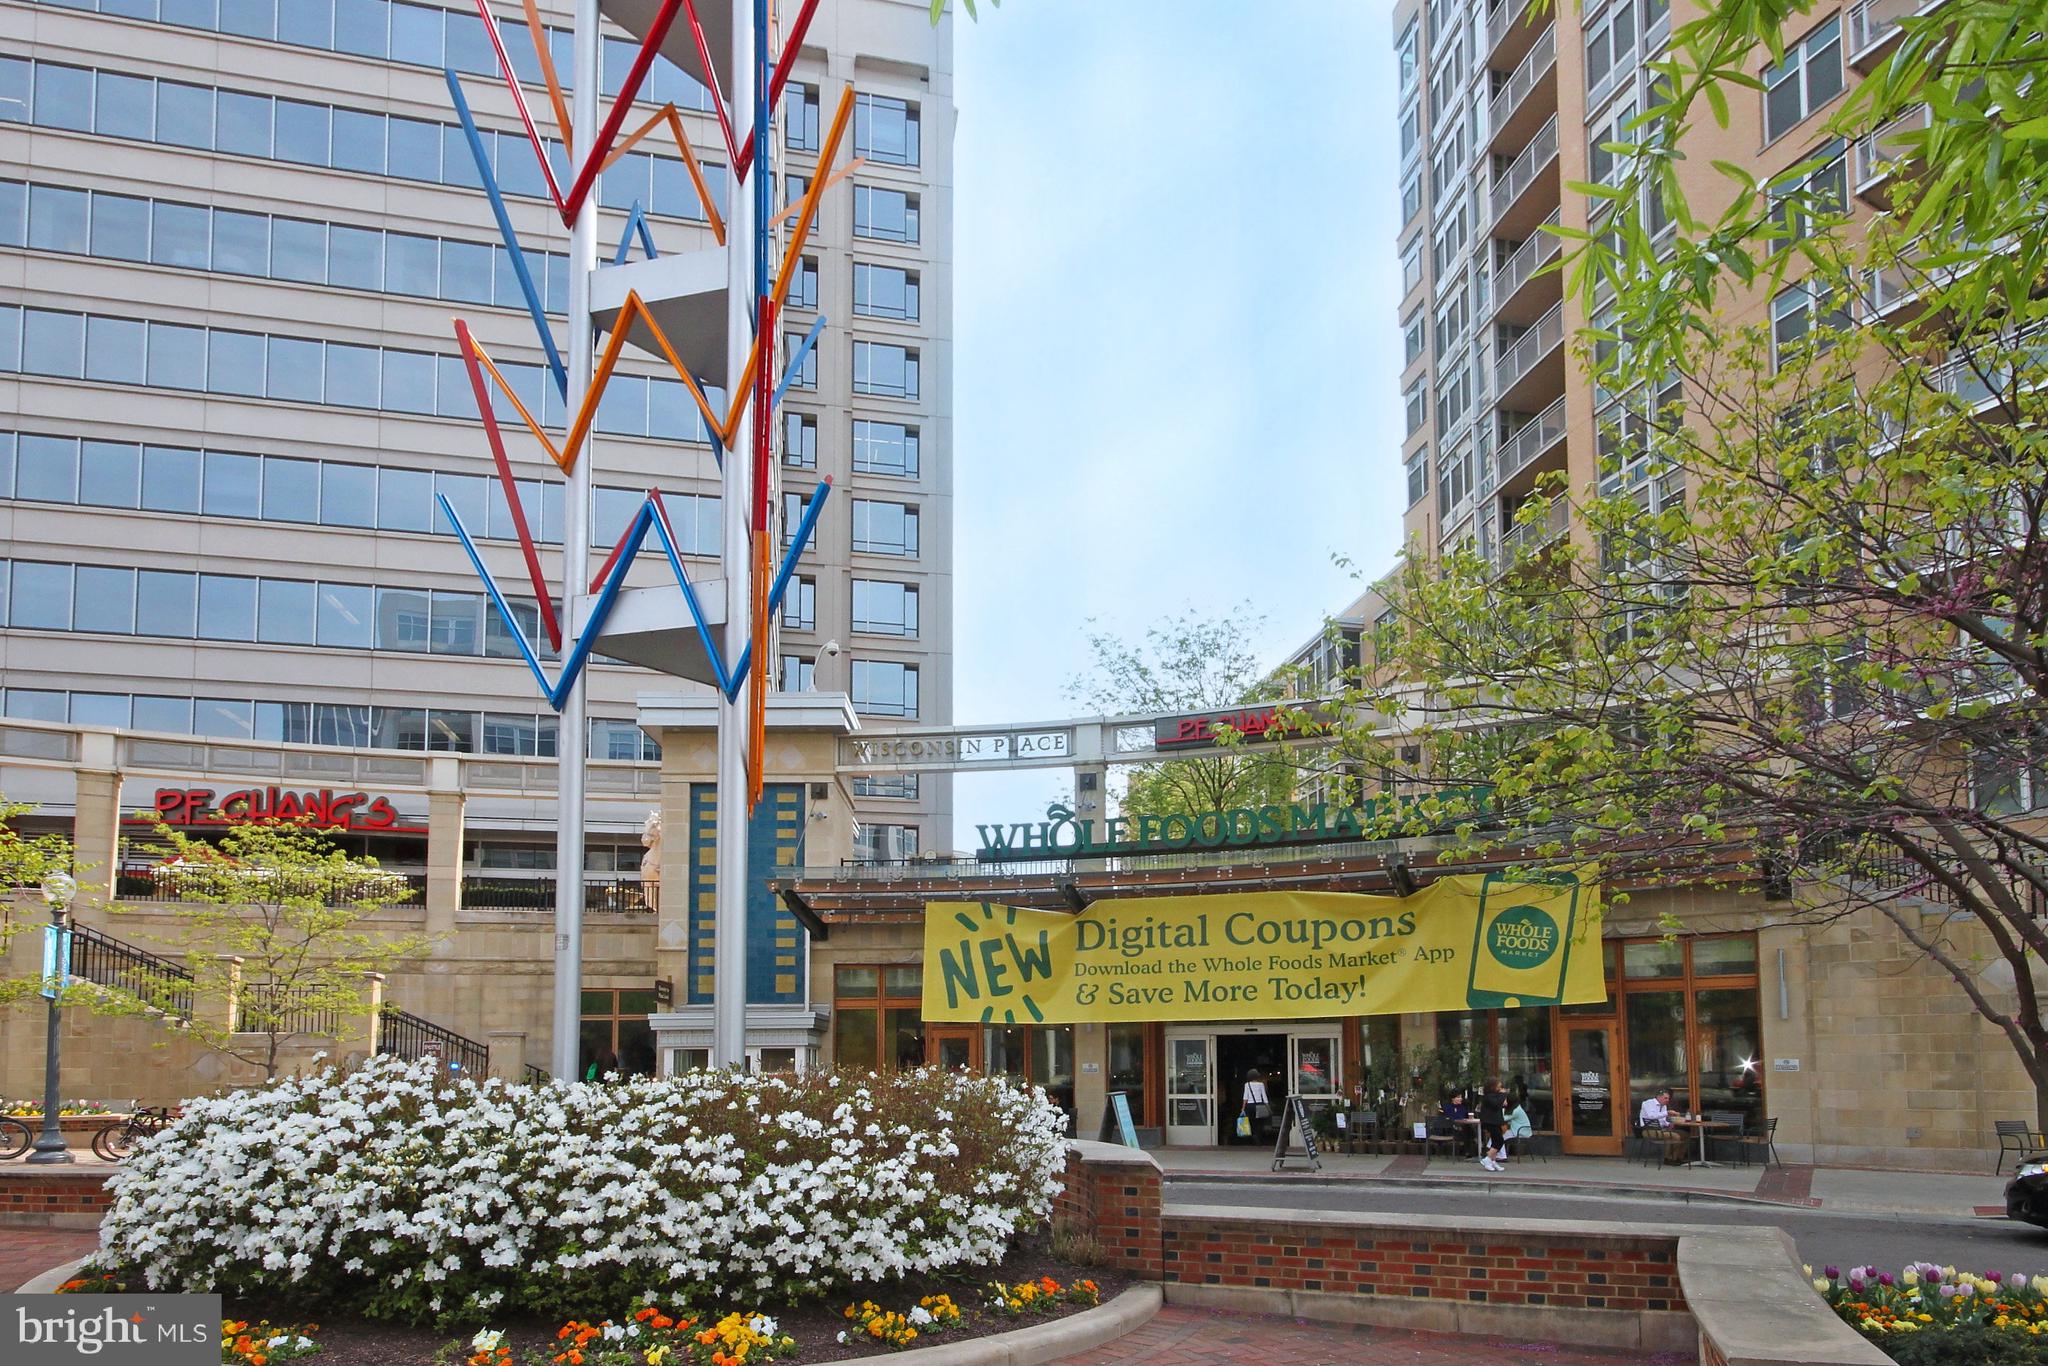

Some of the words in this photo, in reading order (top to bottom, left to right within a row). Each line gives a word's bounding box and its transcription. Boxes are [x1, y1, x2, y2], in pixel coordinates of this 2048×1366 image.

[852, 740, 981, 758] WISCONSIN
[993, 735, 1065, 755] PLACE
[975, 803, 1131, 854] WHOLE
[1138, 806, 1282, 848] FOODS
[1075, 914, 1210, 957] Digital
[1224, 911, 1416, 950] Coupons
[1496, 918, 1552, 939] WHOLE
[1496, 935, 1549, 952] FOODS
[939, 929, 1053, 1009] NEW
[1074, 959, 1162, 977] Download
[1168, 959, 1197, 973] the
[1203, 957, 1262, 973] Whole
[1268, 954, 1322, 971] Foods
[1413, 945, 1455, 964] App
[1501, 949, 1540, 958] MARKET
[1075, 984, 1099, 1006] &
[1108, 982, 1174, 1005] Save
[1183, 980, 1258, 1003] More
[1267, 974, 1366, 1005] Today!
